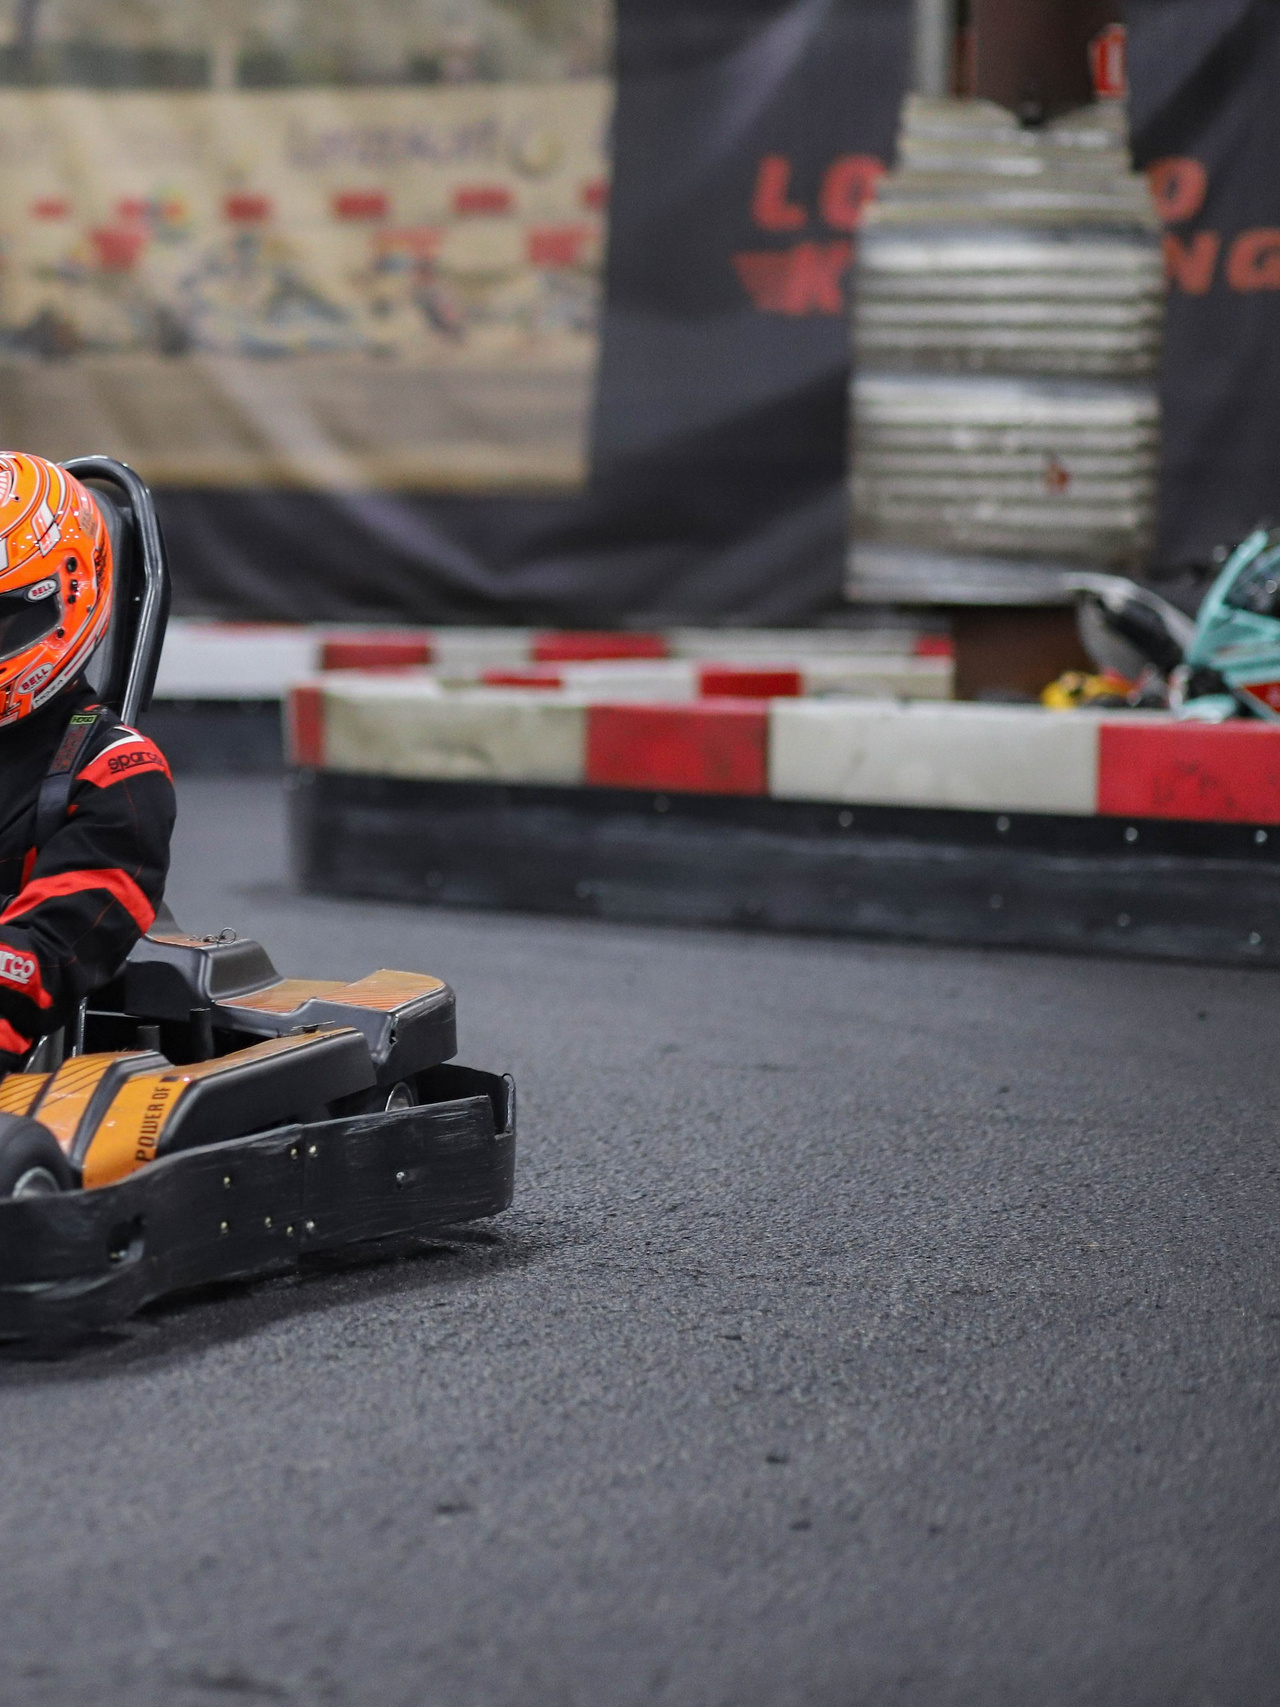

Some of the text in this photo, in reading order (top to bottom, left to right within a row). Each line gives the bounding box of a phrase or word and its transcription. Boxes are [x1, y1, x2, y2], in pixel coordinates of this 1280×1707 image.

[31, 583, 55, 597] BELL
[21, 668, 49, 691] BELL
[135, 1086, 171, 1162] POWER OF
